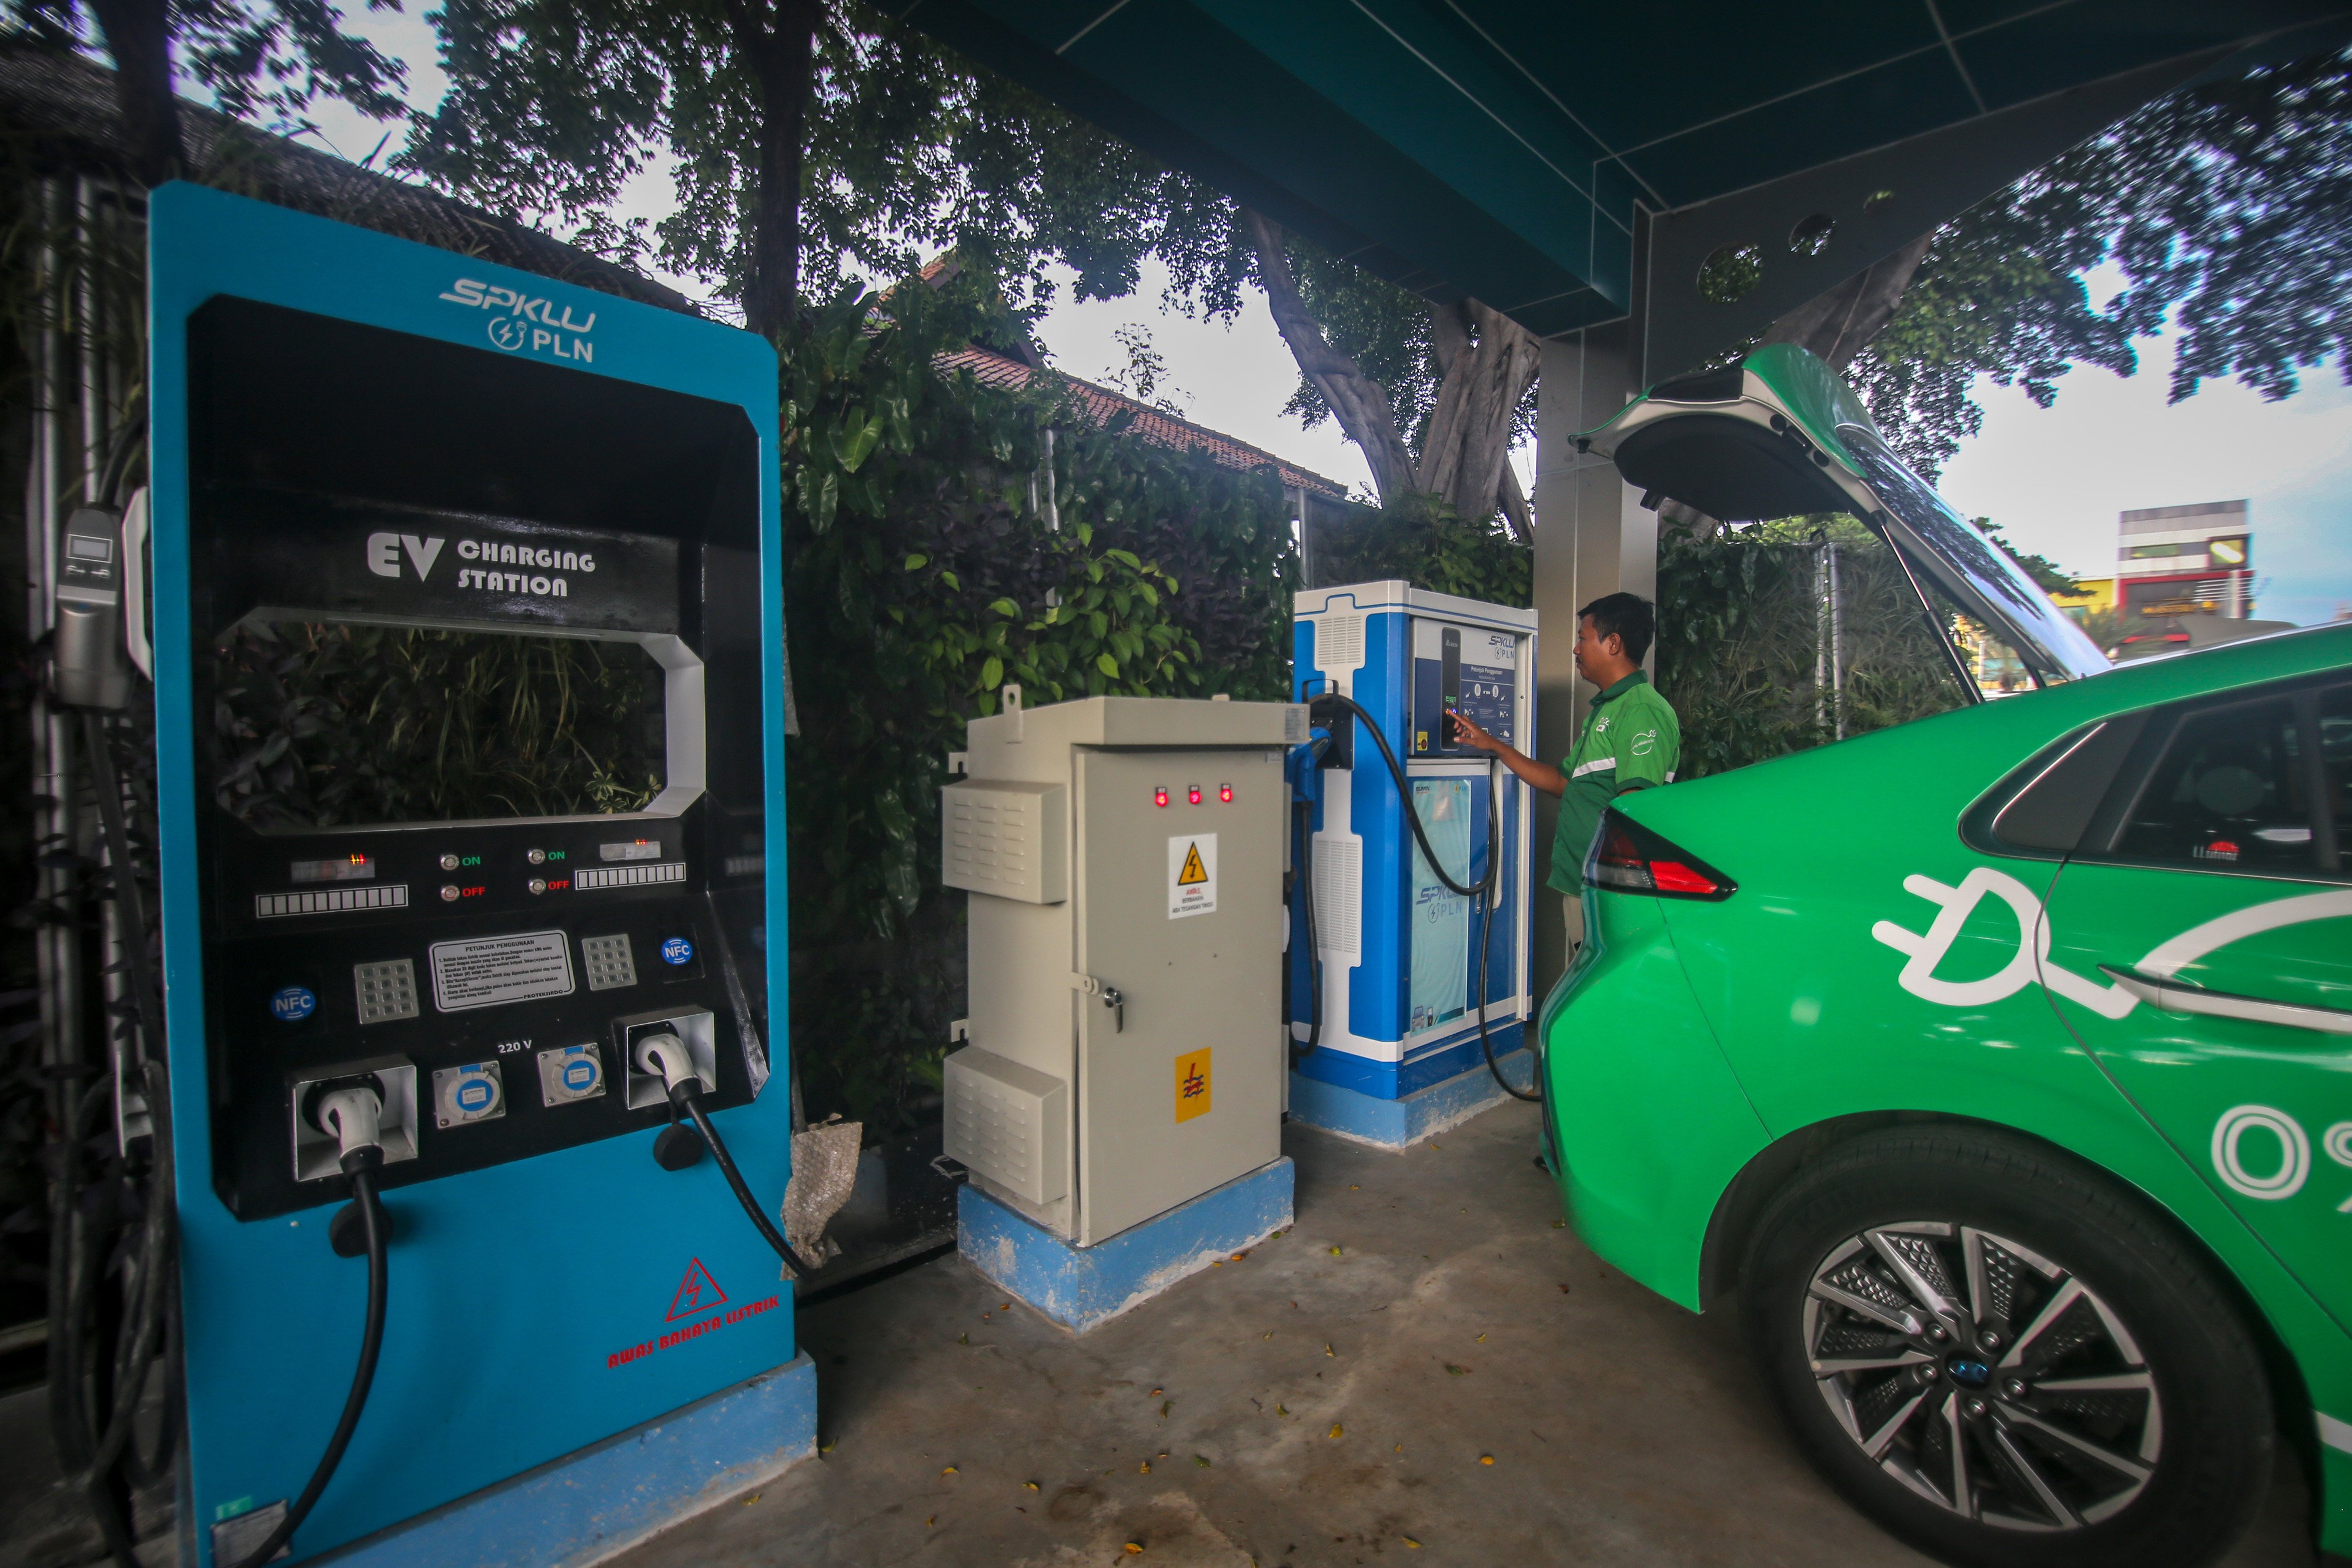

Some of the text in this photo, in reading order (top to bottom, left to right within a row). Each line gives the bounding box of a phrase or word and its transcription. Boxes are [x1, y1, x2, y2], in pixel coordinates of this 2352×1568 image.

[439, 279, 596, 333] SPKLU
[533, 329, 593, 363] PLN
[368, 532, 596, 582] EV CHARGING
[458, 569, 567, 597] STATION
[1488, 635, 1515, 648] SPKLU
[1502, 649, 1514, 659] PLN
[462, 857, 481, 866] ON
[548, 851, 565, 860] ON
[462, 887, 486, 897] OFF
[548, 881, 569, 890] OFF
[1441, 901, 1462, 917] PLN
[465, 940, 534, 952] PETUNJUK PENGGUNAAN
[664, 945, 690, 958] NFC
[523, 989, 563, 999] PROTEKSINDO
[275, 995, 312, 1012] NFC
[497, 1039, 532, 1053] 220 V
[607, 1295, 780, 1369] AWAS BAHAYA LISTRIK
